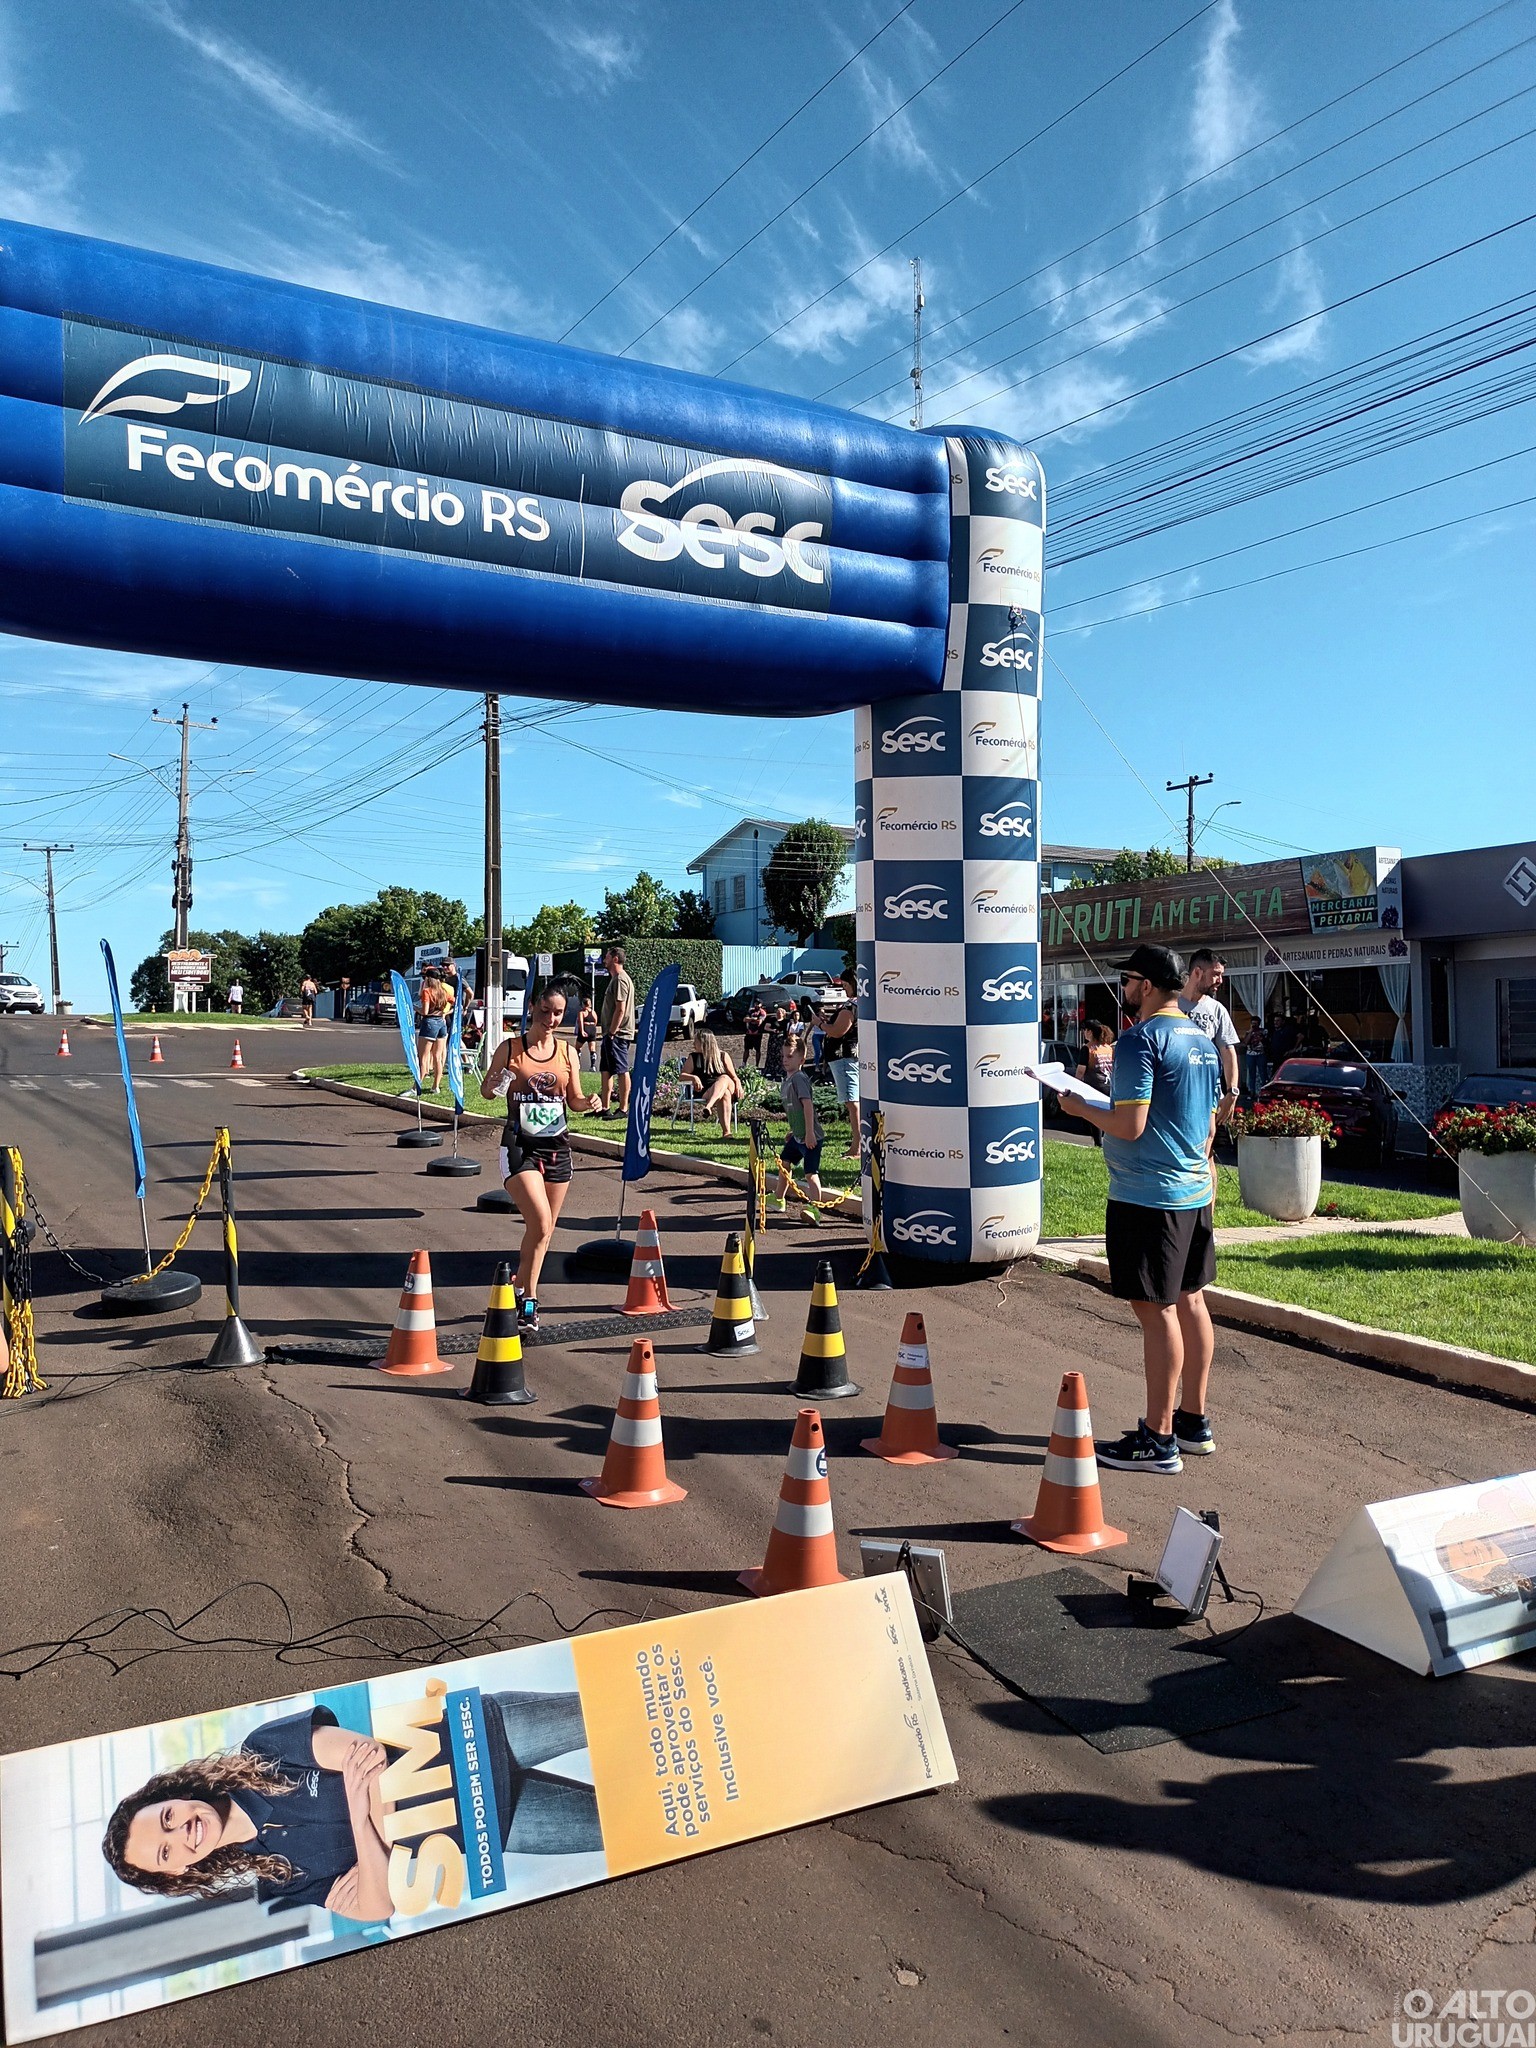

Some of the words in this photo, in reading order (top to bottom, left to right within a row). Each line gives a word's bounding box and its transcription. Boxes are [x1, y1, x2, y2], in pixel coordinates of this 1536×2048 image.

[126, 423, 465, 526] Fecomércio
[481, 490, 550, 542] RS
[983, 562, 1033, 578] Fecomércio
[975, 736, 1027, 748] Fecomércio
[880, 821, 938, 831] Fecomércio
[941, 820, 957, 830] RS
[977, 904, 1028, 914] Fecomércio
[1151, 887, 1283, 928] AMETISTA
[1312, 896, 1376, 912] MERCEARIA
[1319, 912, 1373, 926] PEIXARIA
[1283, 950, 1321, 961] ARTESANATO
[1322, 949, 1327, 959] E
[1328, 947, 1353, 958] PEDRAS
[1354, 945, 1386, 957] NATURAIS
[883, 984, 941, 996] Fecomércio
[944, 986, 960, 996] RS
[980, 1066, 1025, 1077] Fecomérc
[887, 1144, 945, 1158] Fecomércio
[948, 1150, 964, 1159] RS
[985, 1225, 1033, 1239] Fecomércio
[1132, 1448, 1156, 1460] FILA
[651, 1643, 666, 1667] os
[636, 1651, 659, 1721] mundo
[669, 1649, 687, 1701] Sesc.
[699, 1655, 720, 1708] você.
[459, 1696, 475, 1739] SESC.
[657, 1673, 686, 1775] aproveitar
[678, 1706, 693, 1733] do
[465, 1740, 479, 1773] SER
[650, 1726, 669, 1777] todo
[713, 1713, 739, 1801] Inclusive
[685, 1738, 711, 1823] serviços
[469, 1773, 486, 1830] PODEM
[658, 1781, 680, 1836] Aqui,
[676, 1782, 700, 1837] pode
[477, 1832, 494, 1889] TODOS
